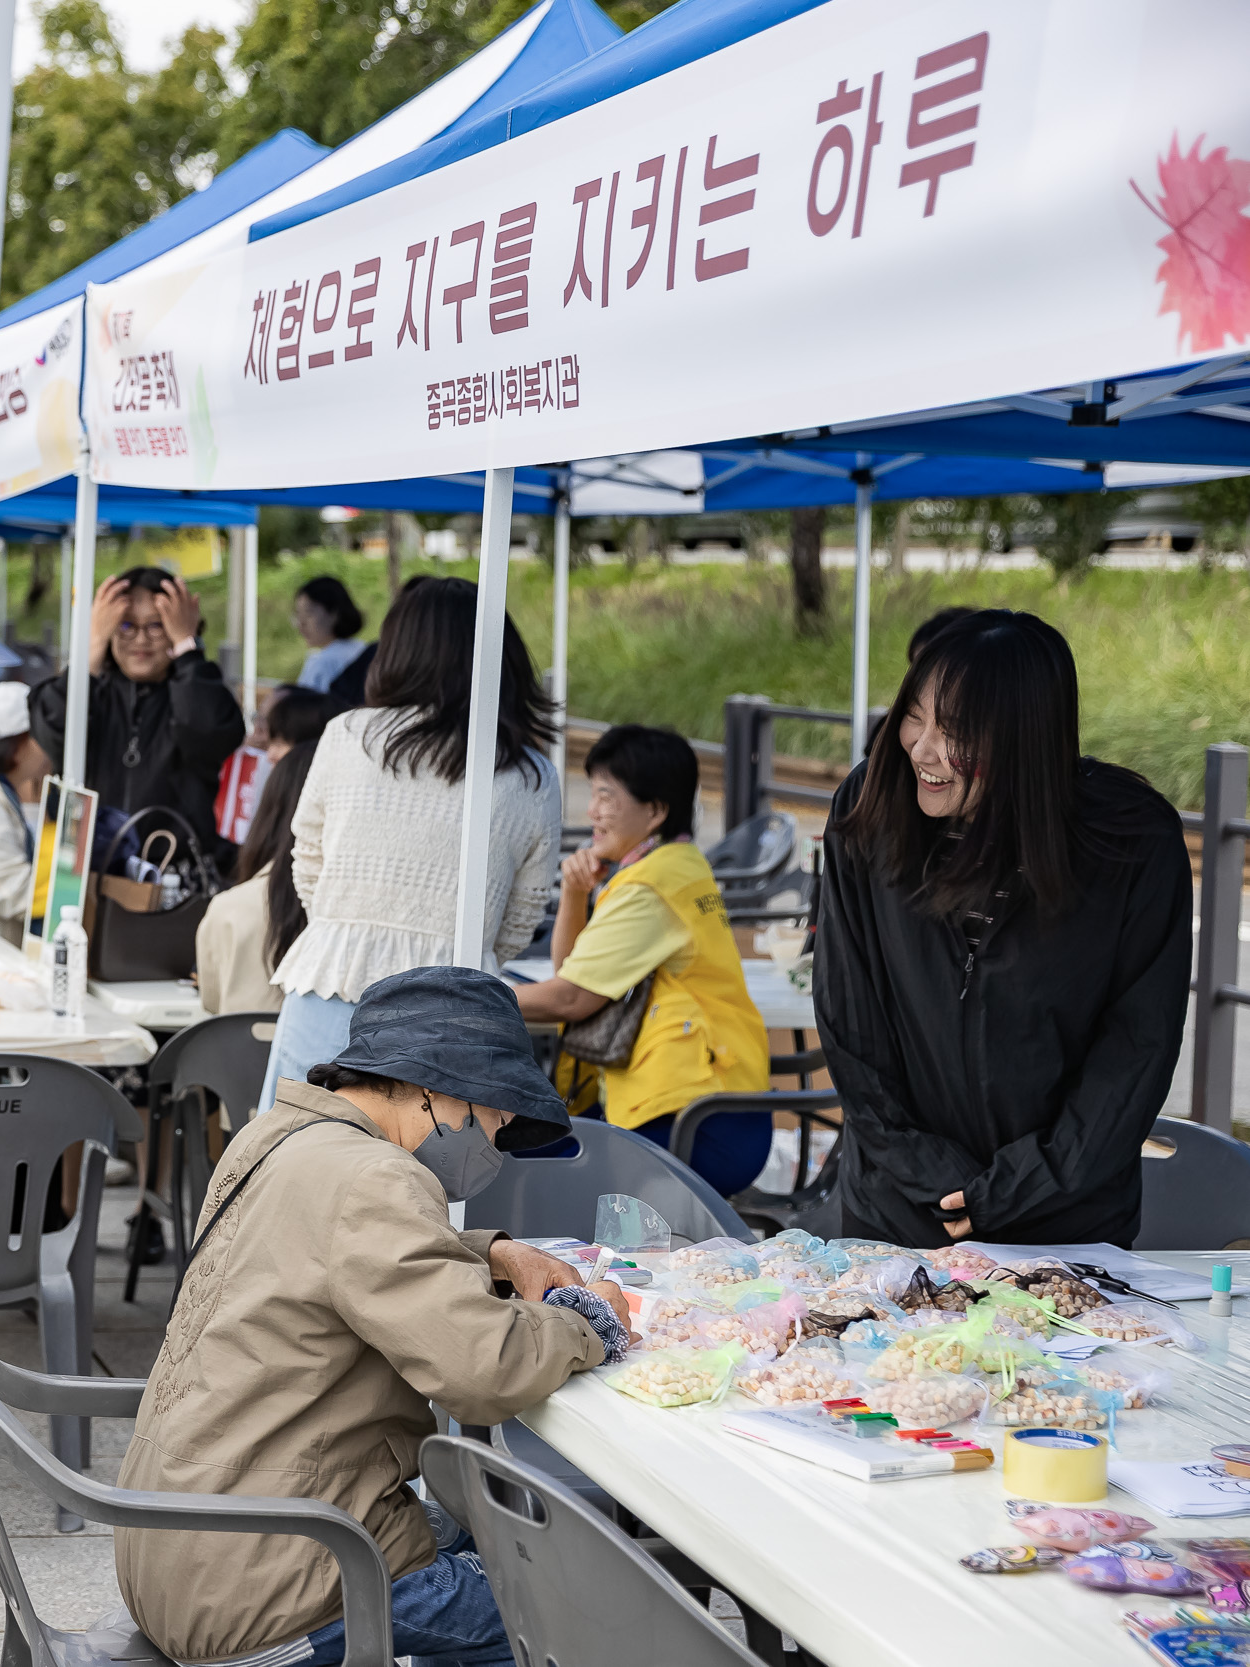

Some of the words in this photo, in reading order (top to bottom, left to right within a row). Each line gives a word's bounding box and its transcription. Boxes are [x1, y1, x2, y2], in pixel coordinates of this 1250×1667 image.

[244, 256, 382, 385] 체험으로
[397, 201, 538, 352] 지구를
[563, 134, 761, 309] 지키는
[806, 31, 990, 239] 하루
[426, 354, 580, 431] 중곡종합사회복지관
